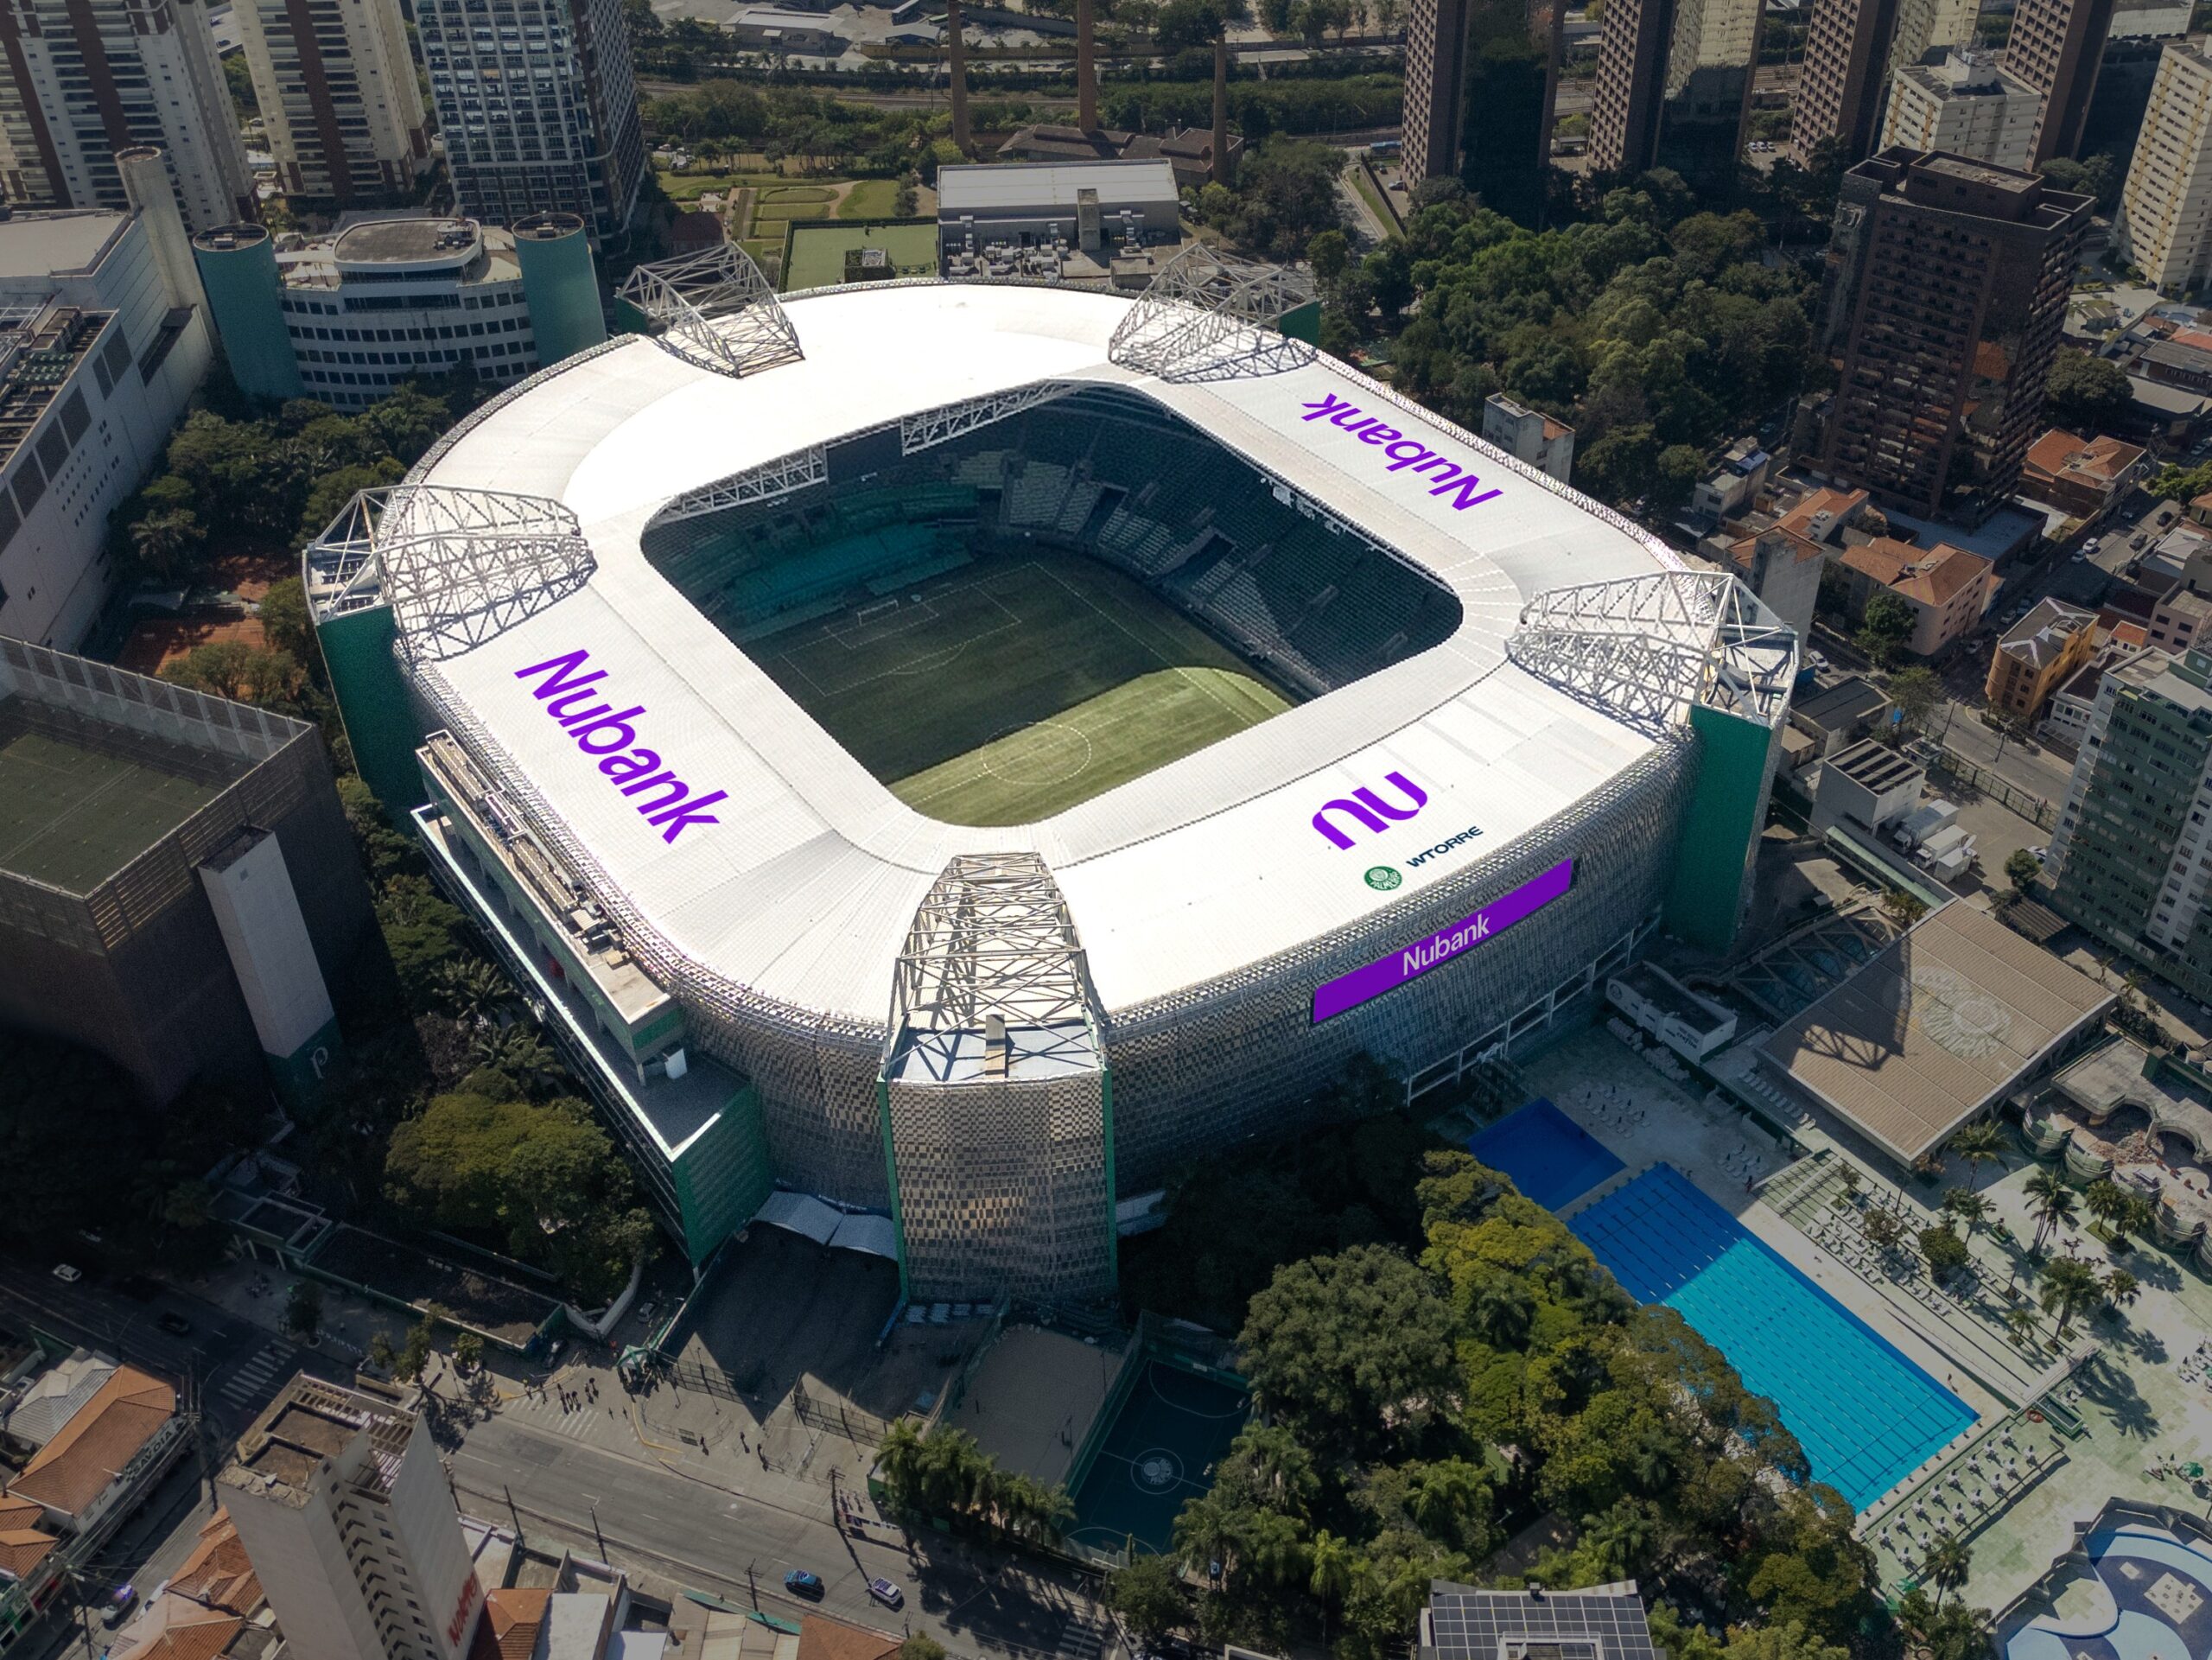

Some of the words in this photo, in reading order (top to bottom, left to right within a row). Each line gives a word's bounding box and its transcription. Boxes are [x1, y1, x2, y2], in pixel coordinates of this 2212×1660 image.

[1302, 394, 1503, 510] Nubank
[515, 650, 728, 843] Nubank
[1406, 825, 1484, 868] WTORRE
[1403, 913, 1491, 976] Nubank
